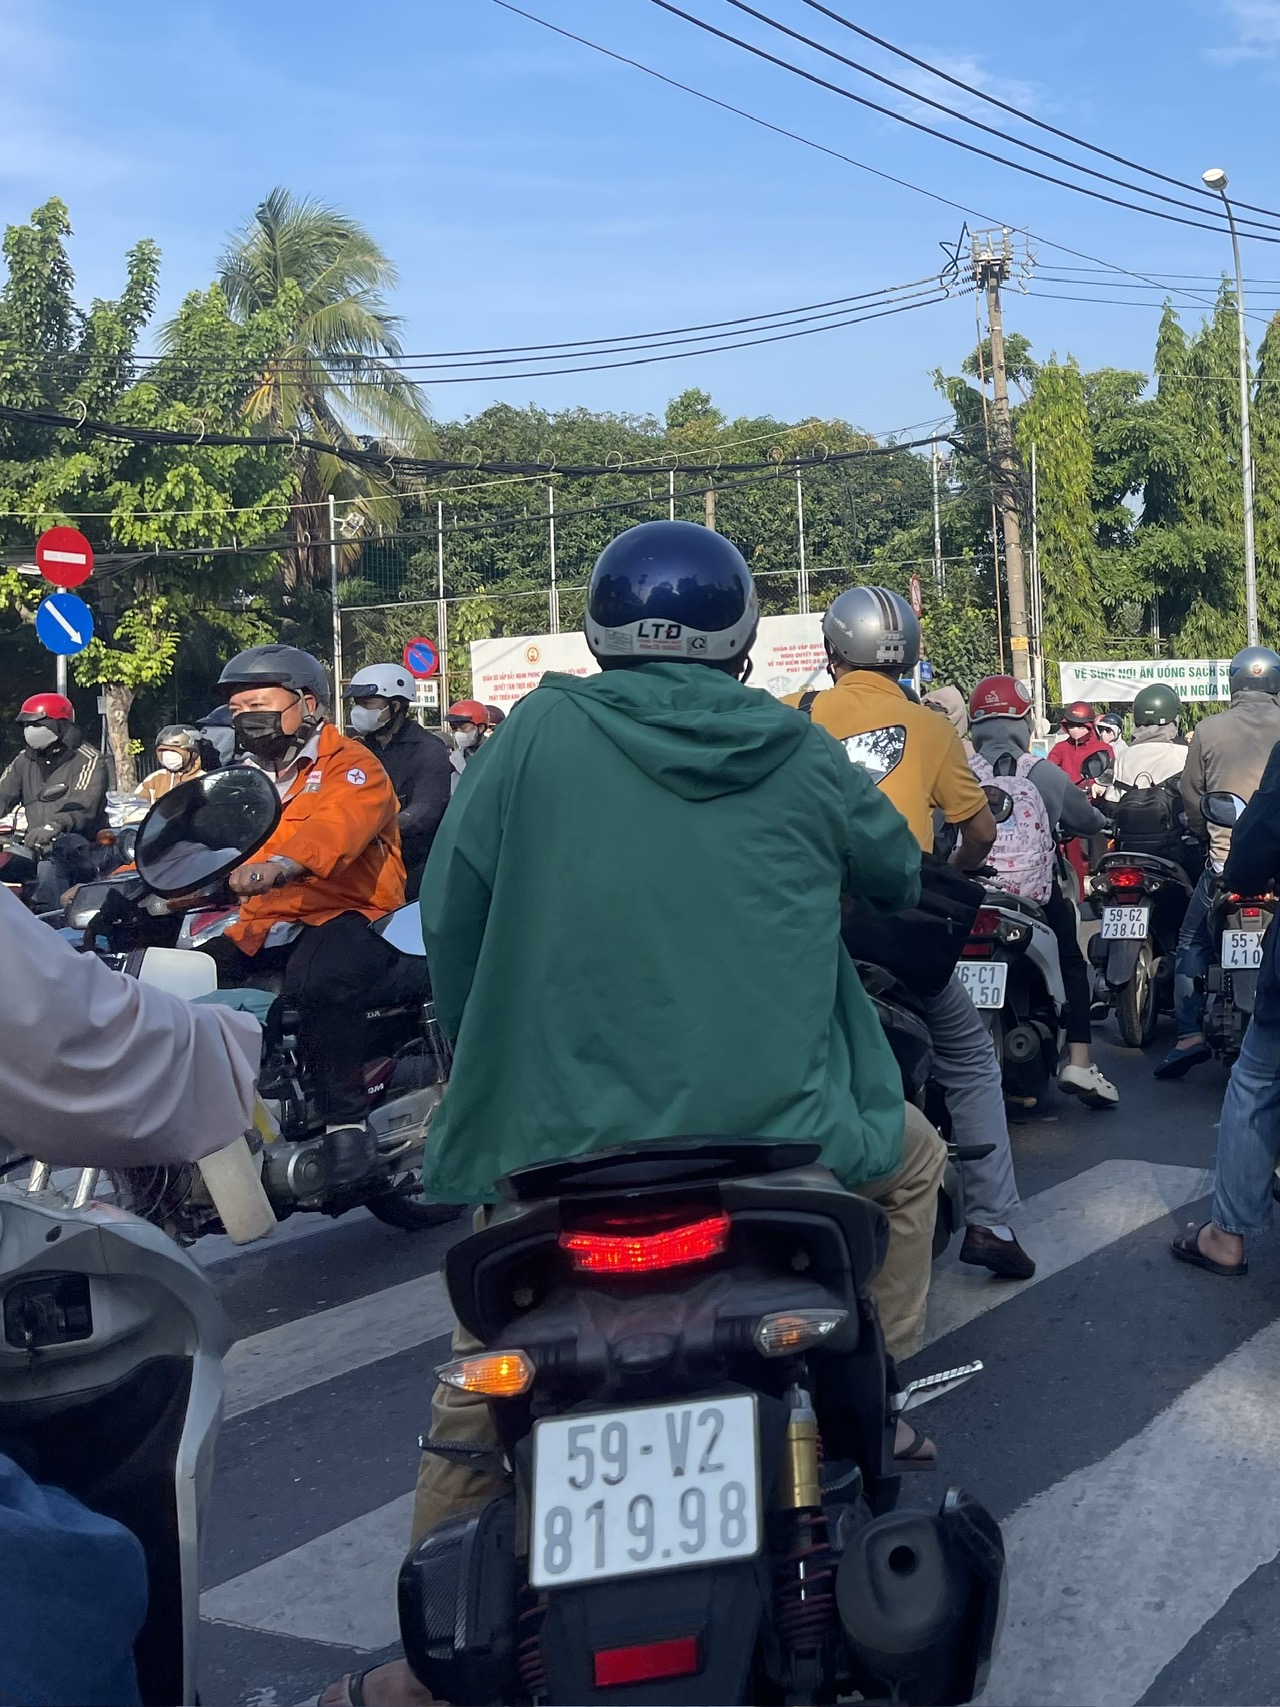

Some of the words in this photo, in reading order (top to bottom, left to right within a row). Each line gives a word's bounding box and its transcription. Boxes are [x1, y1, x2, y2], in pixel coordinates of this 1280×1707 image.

[1139, 664, 1154, 679] ĂN
[1157, 663, 1185, 678] UỐNG
[1188, 666, 1216, 680] SẠCH
[1191, 682, 1218, 696] NGỪA
[1109, 908, 1142, 922] 59-G2
[1104, 923, 1145, 937] 738.40
[1231, 933, 1263, 948] 55-X
[1231, 950, 1260, 965] 410
[567, 1408, 725, 1491] 59-V2
[543, 1481, 747, 1575] 819.98
